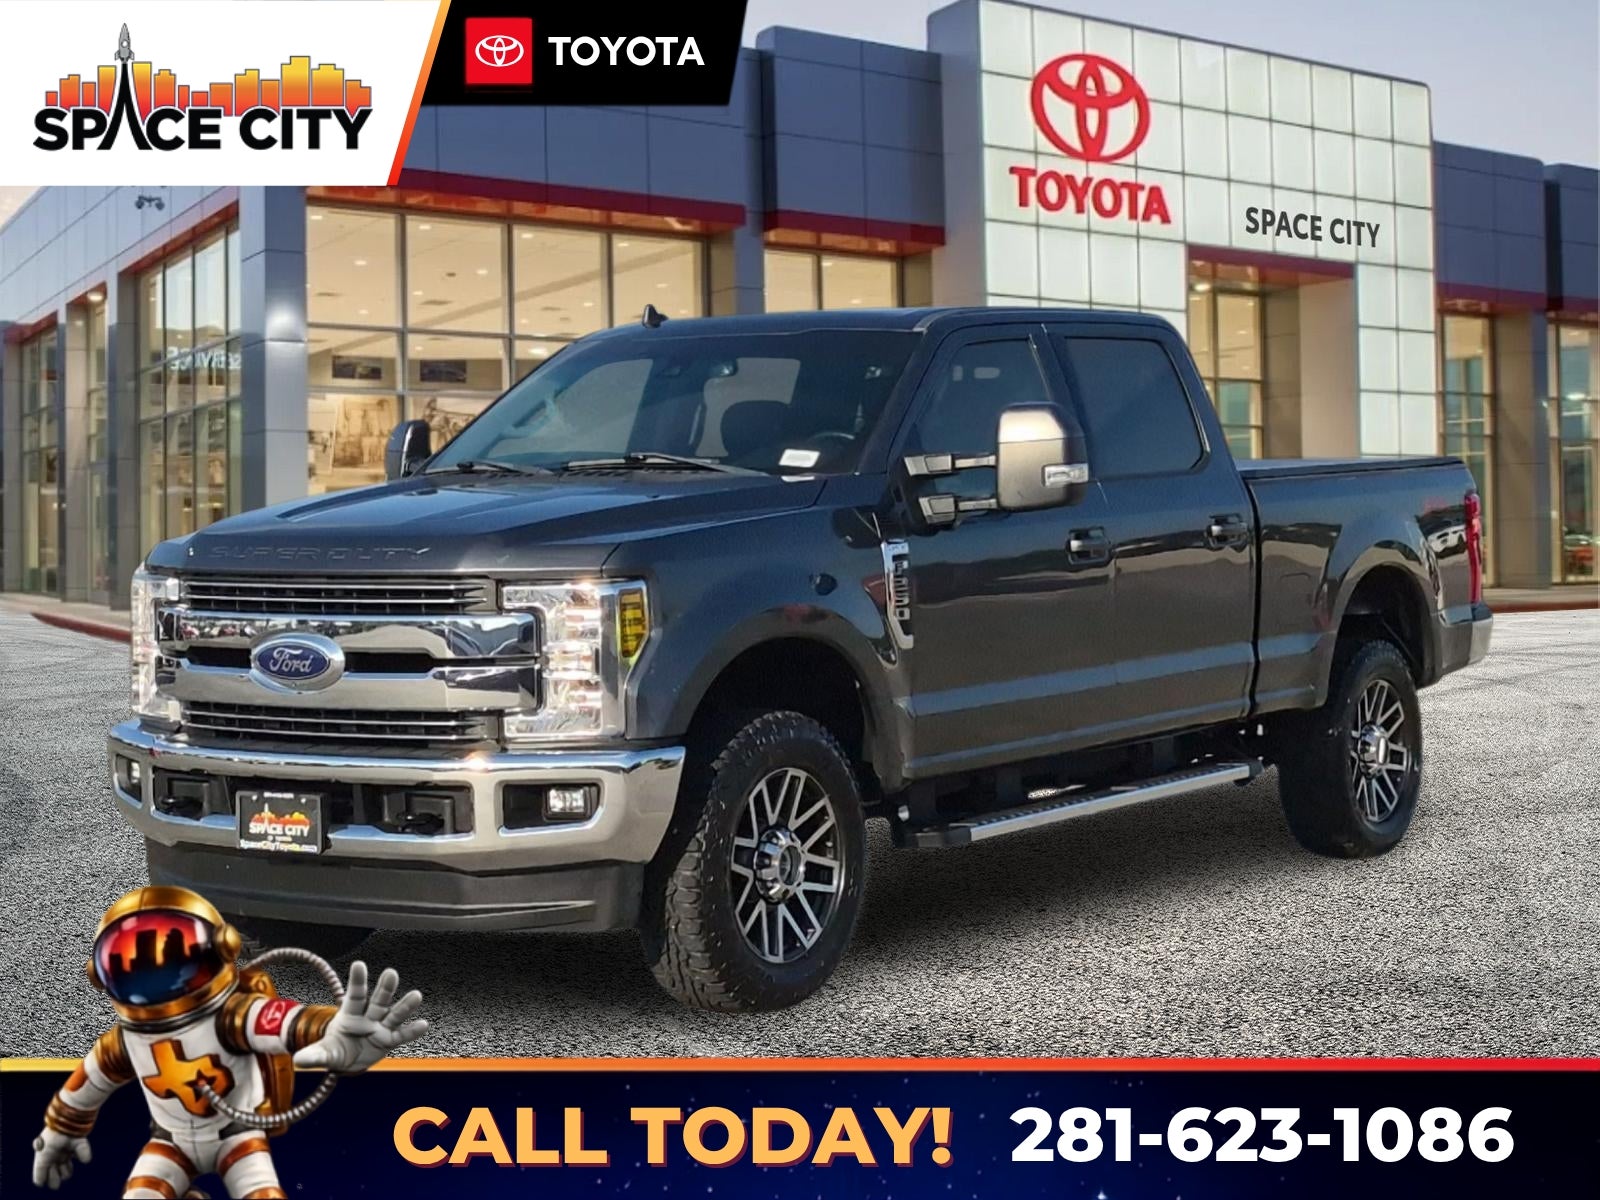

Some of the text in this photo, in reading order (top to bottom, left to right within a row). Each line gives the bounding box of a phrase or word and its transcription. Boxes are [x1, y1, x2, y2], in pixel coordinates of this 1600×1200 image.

[1009, 166, 1171, 224] TOYOTA
[1245, 206, 1381, 248] SPACE CITY
[207, 546, 431, 560] SUPER DUTY
[268, 647, 314, 673] Ford
[249, 821, 311, 837] SPACE CITY
